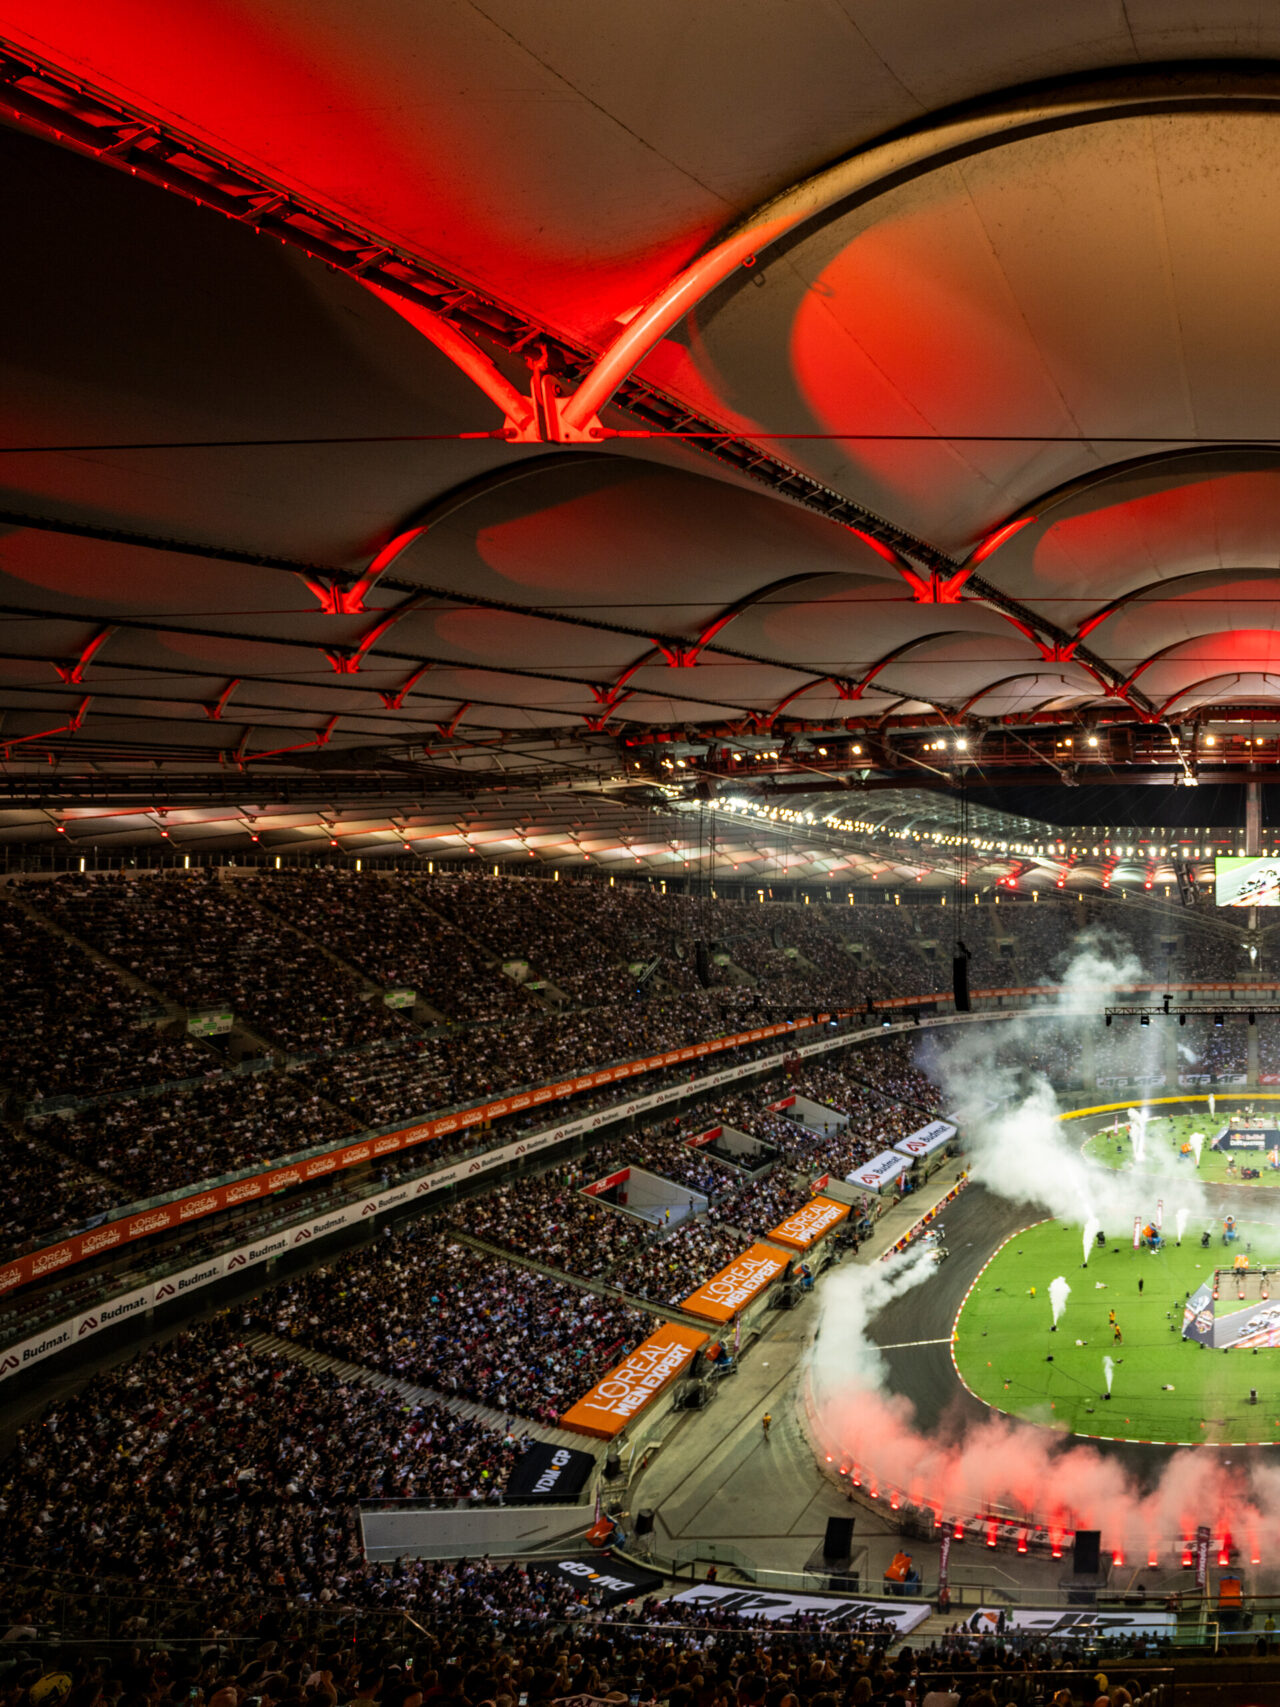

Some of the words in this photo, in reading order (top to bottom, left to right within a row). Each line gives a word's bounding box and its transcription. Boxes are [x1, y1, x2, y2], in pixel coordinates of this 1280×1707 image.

[313, 1216, 347, 1234] Budmat.
[778, 1203, 832, 1238] L'ORÉAL
[795, 1225, 818, 1242] MEN
[810, 1206, 843, 1229] EXPERT
[249, 1239, 288, 1260] Budmat.
[178, 1266, 220, 1289] Budmat.
[701, 1257, 768, 1303] L'ORÉAL
[721, 1286, 752, 1308] MEN
[742, 1260, 782, 1288] EXPERT
[100, 1297, 148, 1323] Budmat.
[22, 1332, 70, 1361] Budmat.
[584, 1342, 676, 1411] L'ORÉAL
[611, 1386, 653, 1416] MEN
[640, 1344, 692, 1388] EXPERT
